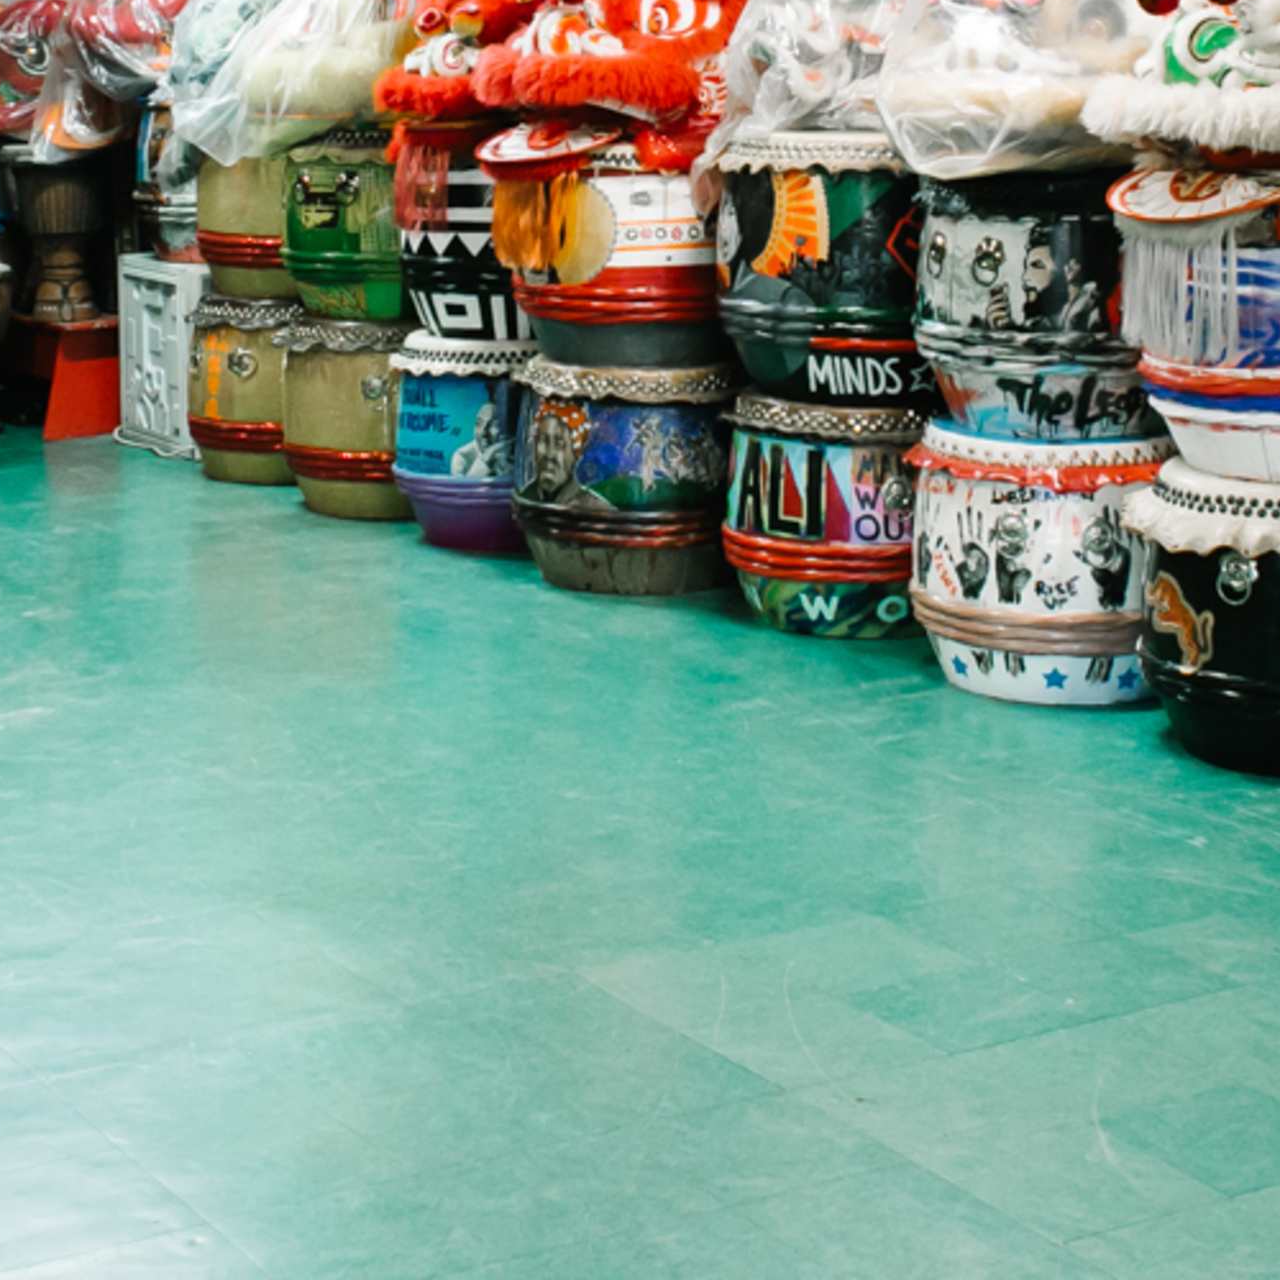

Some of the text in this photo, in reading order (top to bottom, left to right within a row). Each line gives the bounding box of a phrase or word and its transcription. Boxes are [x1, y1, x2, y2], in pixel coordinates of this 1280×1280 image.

[808, 354, 903, 397] MINDS
[854, 514, 905, 541] OU
[1034, 575, 1080, 597] RISE
